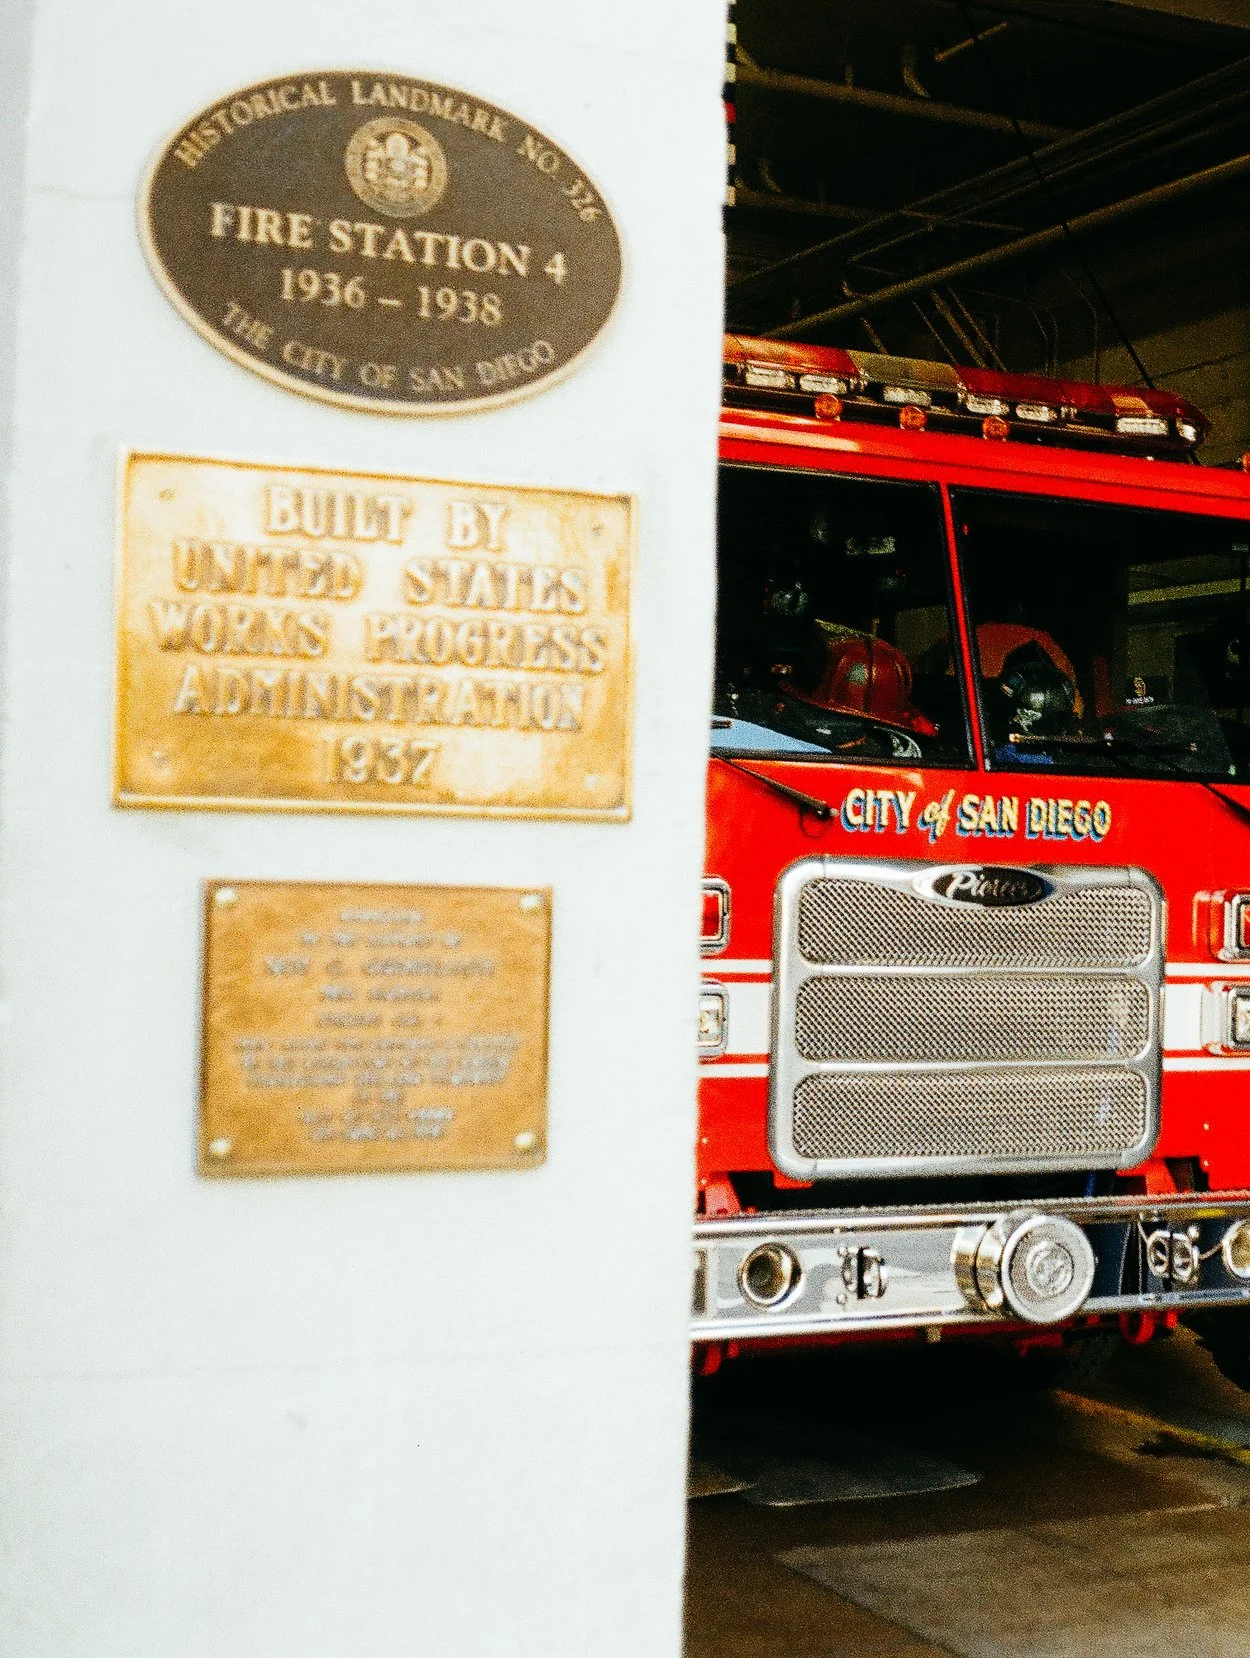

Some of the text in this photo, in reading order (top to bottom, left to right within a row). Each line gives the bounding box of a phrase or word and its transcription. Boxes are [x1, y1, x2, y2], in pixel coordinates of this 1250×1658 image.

[174, 80, 337, 168] HISTORICAL
[351, 80, 507, 141] LANDMARK
[210, 202, 568, 285] FIRE STATION 4
[281, 268, 366, 309] 1936
[416, 285, 501, 326] 1938
[222, 300, 556, 392] THE CITY OF SAN DIEGO
[264, 483, 510, 551] BUILT BY
[172, 538, 588, 615] UNITED STATES
[149, 601, 609, 672] WORKS PROGRESS
[172, 667, 584, 732] ADMINISTRATION
[841, 788, 1112, 843] CITY of SAN DIEGO
